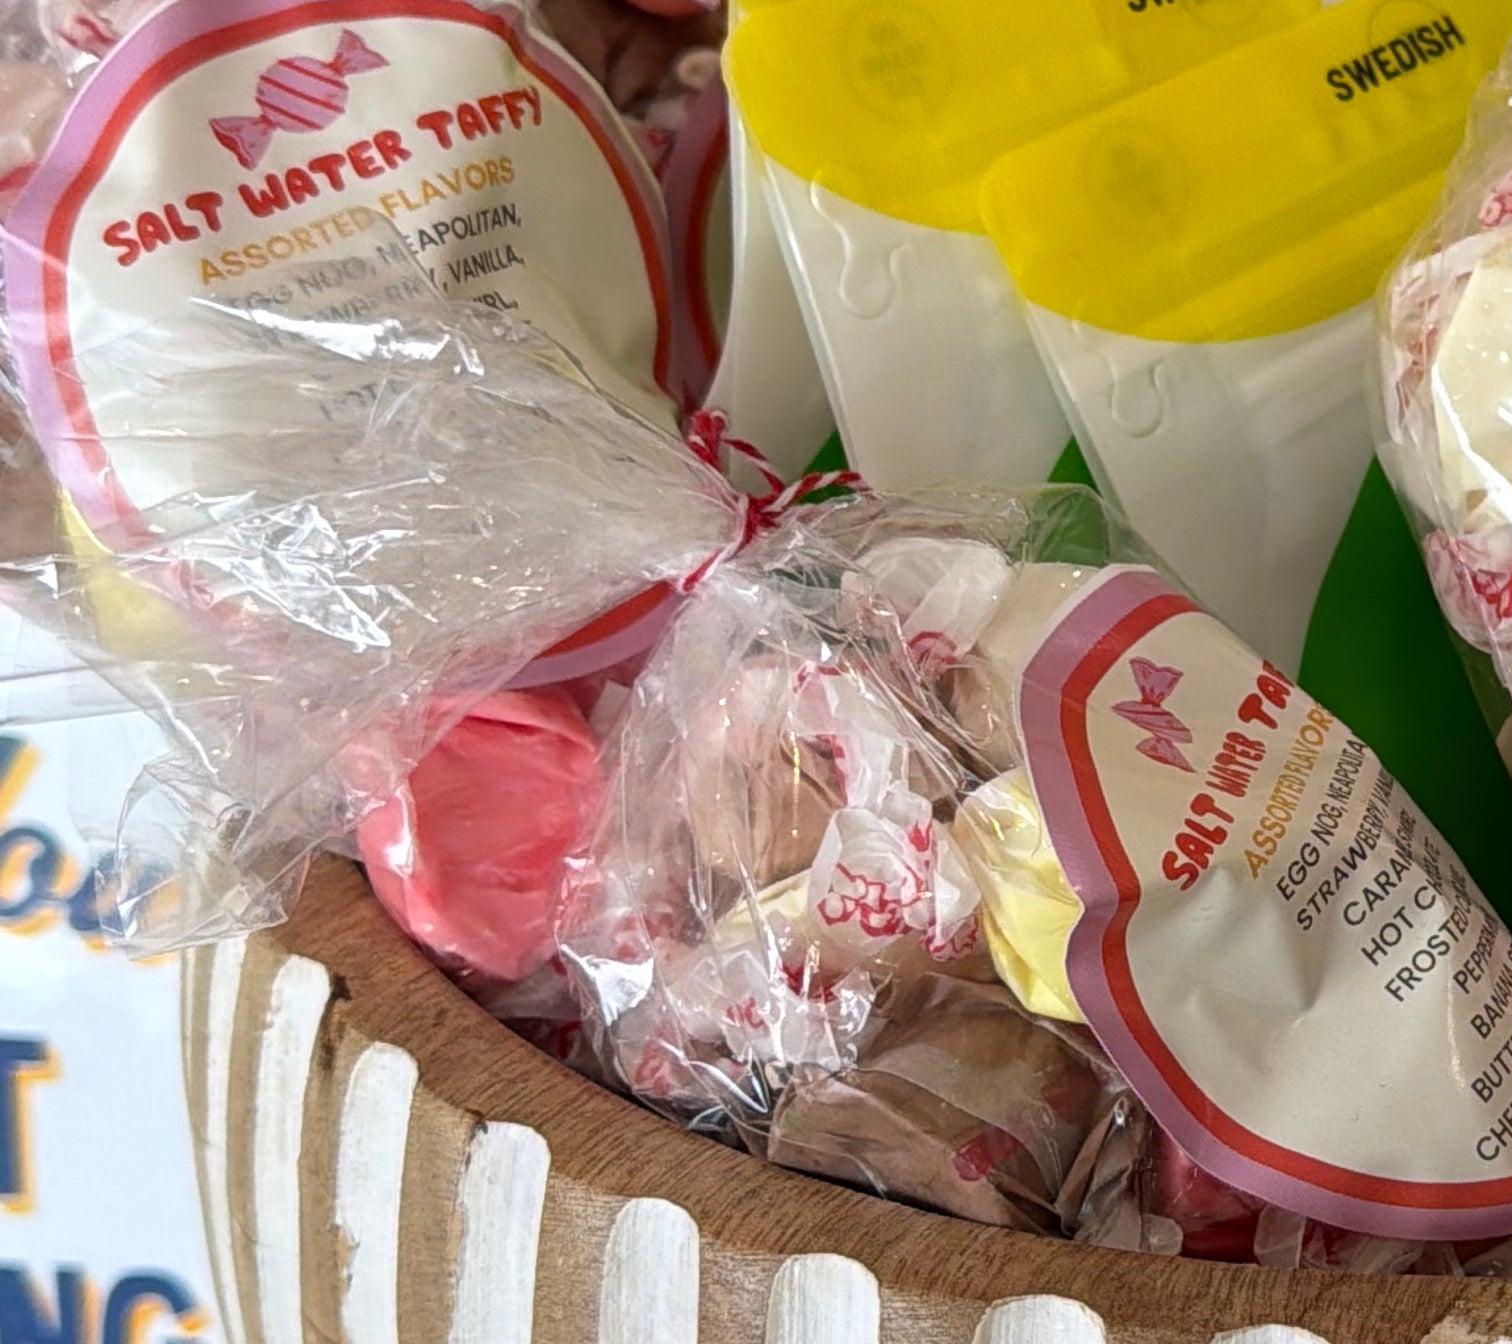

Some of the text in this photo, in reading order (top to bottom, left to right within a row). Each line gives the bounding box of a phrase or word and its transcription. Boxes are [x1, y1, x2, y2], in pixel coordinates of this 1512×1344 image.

[1326, 14, 1466, 103] SWEDISH
[102, 86, 543, 267] SALT WATER TAFFY
[200, 156, 515, 287] ASSORTED FLAVORS
[446, 244, 526, 286] VANILLA,
[1161, 792, 1235, 892] SALT
[1204, 730, 1268, 798] WATER
[1242, 702, 1335, 880] ASSORTED FLAVOR
[1275, 739, 1369, 902] EGG NOG, NEAPOLITA
[1360, 905, 1414, 967] HOT
[1384, 906, 1470, 1003] FROSTED
